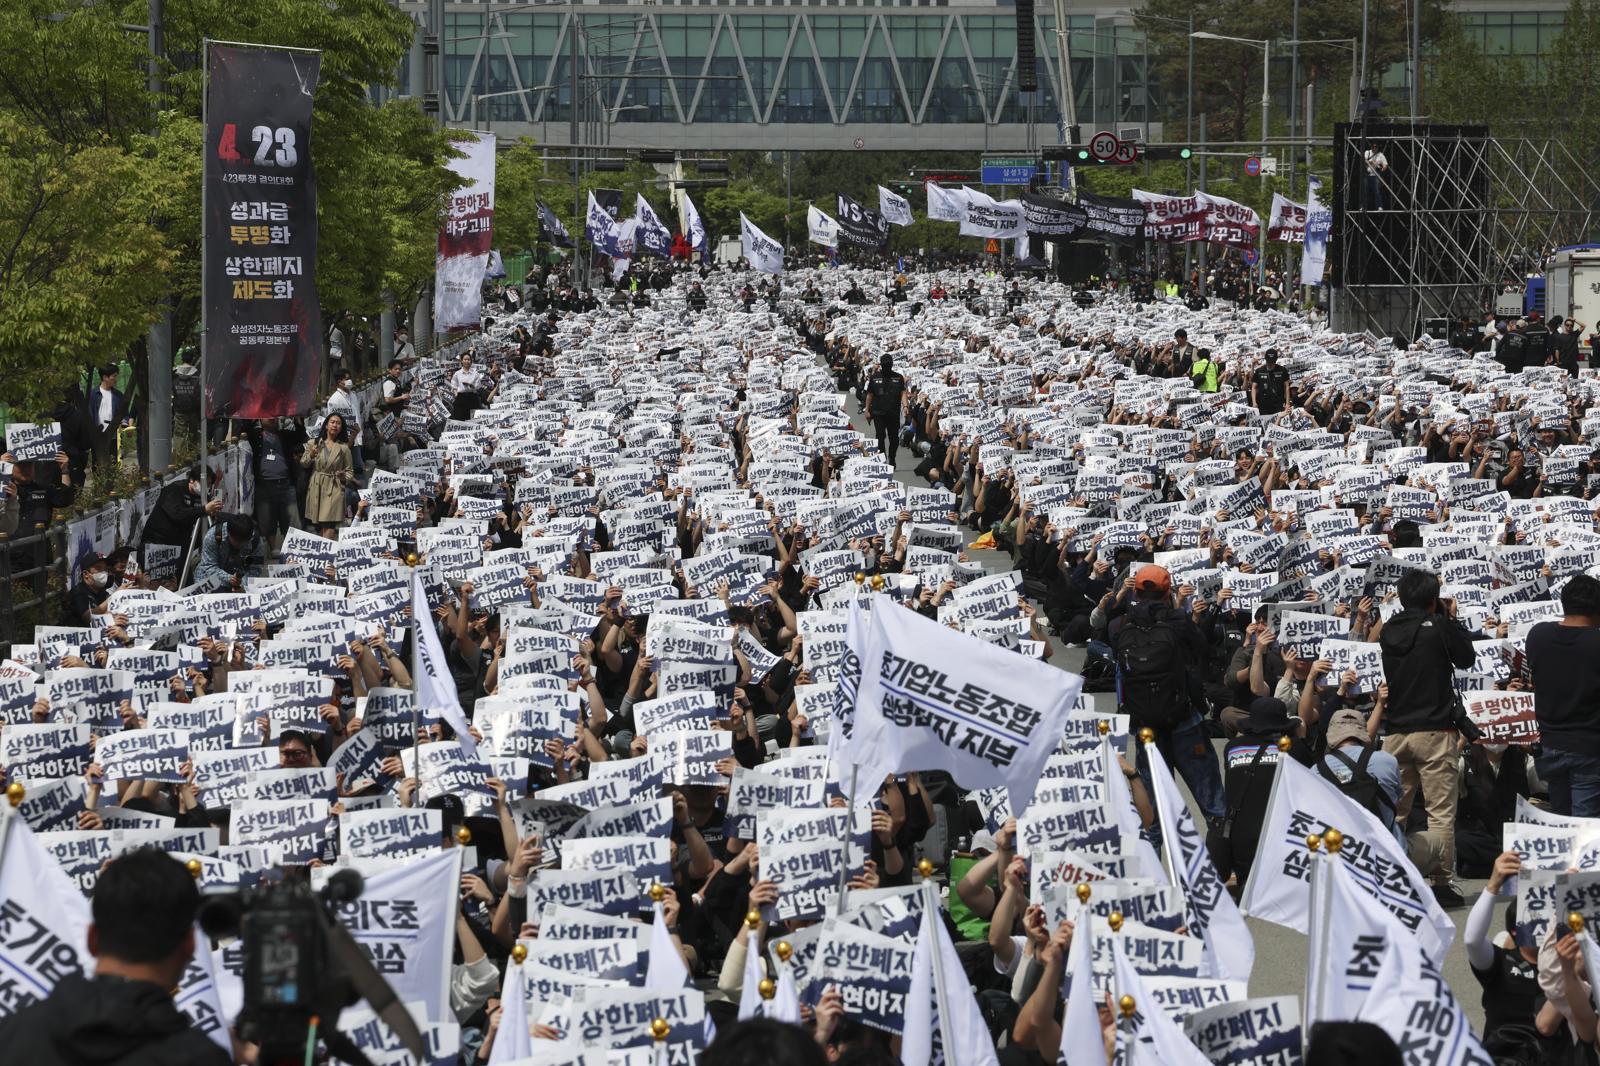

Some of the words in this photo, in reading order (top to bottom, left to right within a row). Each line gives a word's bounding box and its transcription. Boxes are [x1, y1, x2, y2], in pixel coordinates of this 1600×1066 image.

[1096, 140, 1113, 153] 50
[230, 202, 289, 221] 성과급
[446, 216, 490, 236] 바꾸고!!!
[1000, 219, 1018, 229] 지부
[1144, 221, 1200, 239] 바꾸고!!!
[230, 226, 291, 245] 투명화
[225, 256, 303, 276] 상한폐지
[233, 280, 294, 300] 제도화
[231, 324, 298, 334] 삼성전자노동조합
[239, 336, 291, 345] 공동투쟁본부
[1537, 407, 1564, 418] 상한폐지
[10, 424, 54, 444] 상한폐지
[826, 432, 856, 446] 상한폐지
[1155, 433, 1187, 442] 상한폐지
[15, 442, 62, 460] 실현하자
[516, 441, 547, 454] 상한폐지
[1035, 447, 1066, 457] 상한폐지
[1154, 445, 1186, 457] 상한폐지
[1276, 440, 1307, 456] 상한폐지
[853, 464, 888, 476] 상한폐지
[1118, 456, 1151, 467] 상한폐지
[1545, 461, 1577, 473] 상한폐지
[1080, 475, 1117, 486] 상한폐지
[1197, 470, 1230, 485] 상한폐지
[1338, 474, 1376, 490] 상한폐지
[1547, 472, 1581, 483] 실현하자
[375, 484, 414, 501] 상한폐지
[553, 488, 591, 505] 상한폐지
[606, 483, 638, 500] 상한폐지
[1028, 486, 1064, 501] 상한폐지
[1220, 482, 1255, 510] 상한폐지
[1390, 491, 1431, 502] 상한폐지
[1451, 482, 1490, 496] 상한폐지
[461, 500, 498, 509] 상한폐지
[909, 493, 950, 506] 상한폐지
[1549, 500, 1589, 511] 상한폐지
[371, 511, 411, 525] 상한폐지
[633, 502, 672, 520] 상한폐지
[727, 512, 766, 526] 상한폐지
[833, 505, 864, 528] 상한폐지
[911, 509, 952, 522] 실현하자
[1143, 505, 1181, 521] 상한폐지
[1392, 506, 1429, 518] 실현하자
[618, 521, 657, 539] 상한폐지
[288, 536, 333, 553] 상한폐지
[430, 537, 470, 550] 상한폐지
[912, 534, 955, 546] 상한폐지
[1339, 535, 1380, 553] 상한폐지
[430, 552, 474, 566] 상한폐지
[488, 551, 530, 566] 상한폐지
[1246, 536, 1283, 565] 상한폐지
[1346, 547, 1388, 564] 실현하자
[1430, 545, 1479, 568] 상한폐지
[1499, 548, 1546, 565] 상한폐지
[594, 553, 641, 573] 상한폐지
[688, 553, 735, 580] 상한폐지
[813, 552, 855, 574] 상한폐지
[909, 553, 952, 567] 상한폐지
[1550, 552, 1594, 571] 상한폐지
[352, 569, 399, 592] 상한폐지
[472, 568, 521, 589] 상한폐지
[617, 572, 663, 588] 상한폐지
[1444, 563, 1490, 582] 상한폐지
[1228, 576, 1272, 591] 상한폐지
[479, 585, 528, 605] 실현하자
[627, 587, 674, 604] 상한폐지
[1490, 580, 1541, 615] 상한폐지
[200, 596, 253, 615] 상한폐지
[294, 597, 348, 614] 상한폐지
[958, 594, 1012, 621] 상한폐지
[1507, 600, 1560, 626] 상한폐지
[1285, 619, 1340, 637] 상한폐지
[513, 637, 571, 653] 상한폐지
[662, 634, 718, 658] 상한폐지
[737, 637, 776, 666] 상한폐지
[264, 646, 322, 666] 상한폐지
[502, 655, 558, 678] 상한폐지
[49, 675, 114, 700] 상한폐지
[666, 668, 727, 691] 상한폐지
[641, 693, 706, 725] 상한폐지
[1470, 695, 1534, 716] 투명하게
[153, 707, 224, 729] 상한폐지
[6, 728, 78, 756] 상한폐지
[101, 732, 176, 759] 상한폐지
[958, 726, 1018, 769] 지부
[11, 757, 90, 778] 실현하자
[105, 757, 182, 778] 실현하자
[194, 752, 268, 781] 상한폐지
[1230, 754, 1282, 768] pataonia
[736, 784, 810, 807] 상한폐지
[235, 803, 314, 835] 상한폐지
[1024, 806, 1106, 845] 상한폐지
[348, 813, 429, 847] 상한폐지
[570, 840, 657, 871] 상한폐지
[766, 847, 851, 883] 상한폐지
[536, 875, 624, 913] 상한폐지
[824, 941, 914, 975] 상한폐지
[580, 994, 688, 1041] 상한폐지
